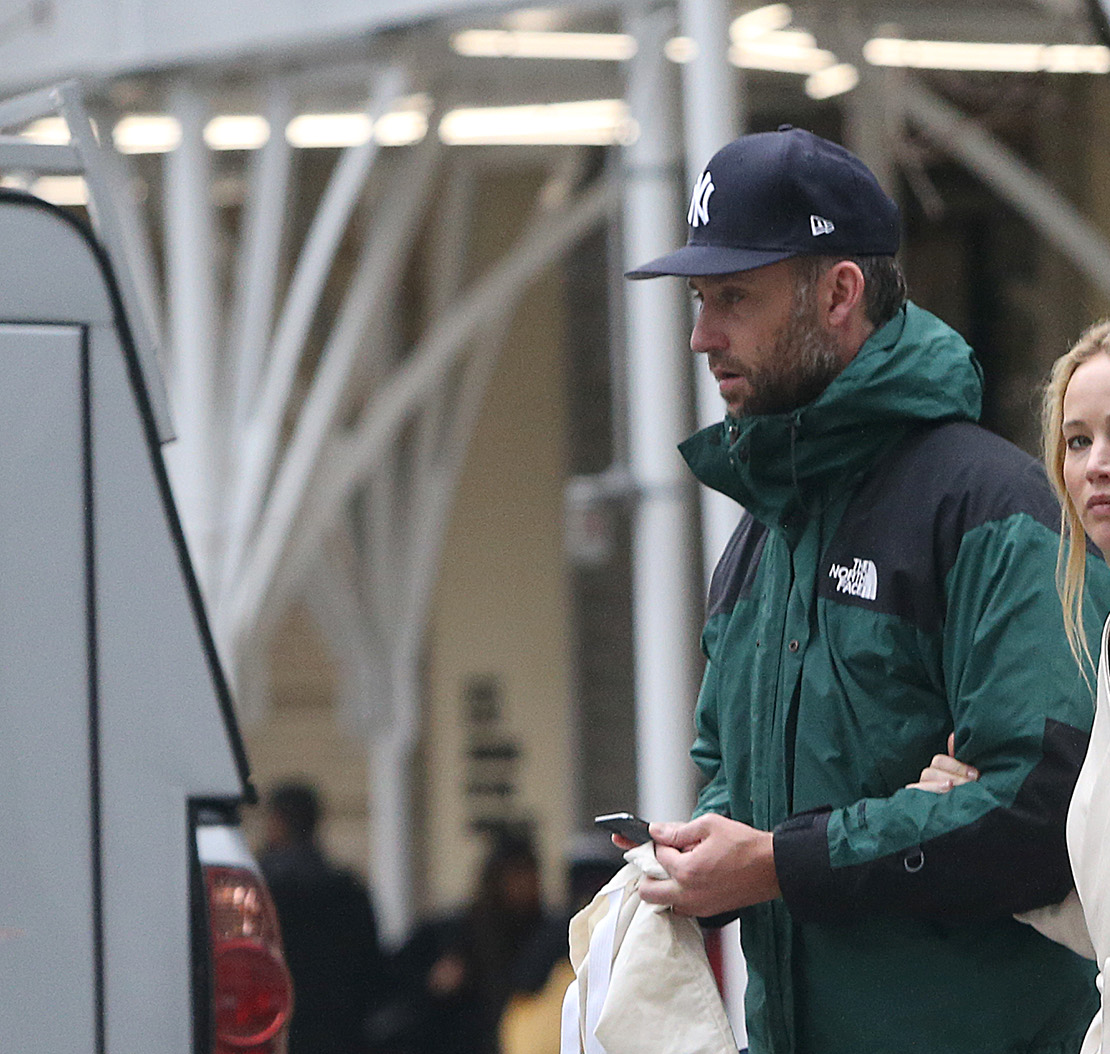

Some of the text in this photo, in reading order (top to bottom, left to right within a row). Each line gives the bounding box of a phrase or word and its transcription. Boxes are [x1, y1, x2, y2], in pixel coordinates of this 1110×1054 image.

[828, 563, 867, 586] NORTH
[853, 557, 869, 575] THE
[836, 578, 867, 598] FACE
